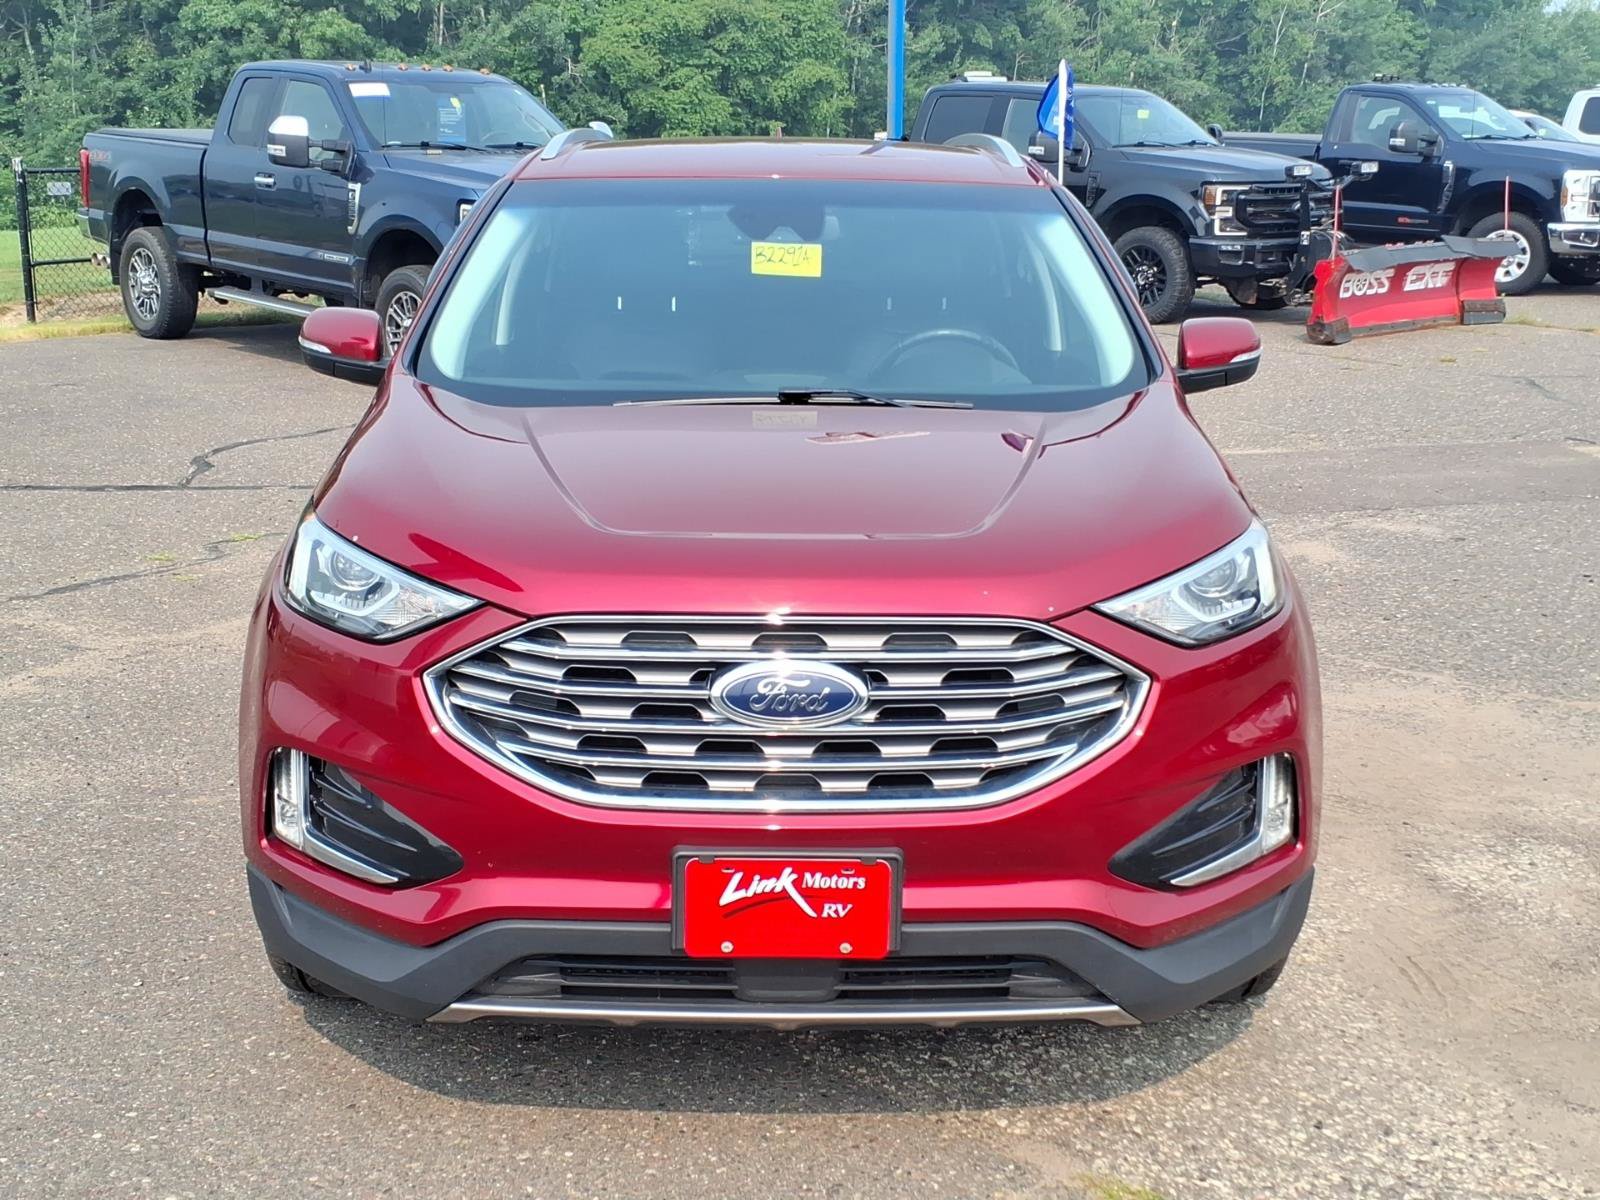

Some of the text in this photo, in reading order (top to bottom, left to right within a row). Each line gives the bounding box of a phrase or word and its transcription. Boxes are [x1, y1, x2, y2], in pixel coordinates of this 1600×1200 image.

[1339, 261, 1456, 298] BOSS EXT
[749, 676, 831, 712] Ford
[719, 867, 866, 917] Link Motors
[821, 902, 853, 918] RV
